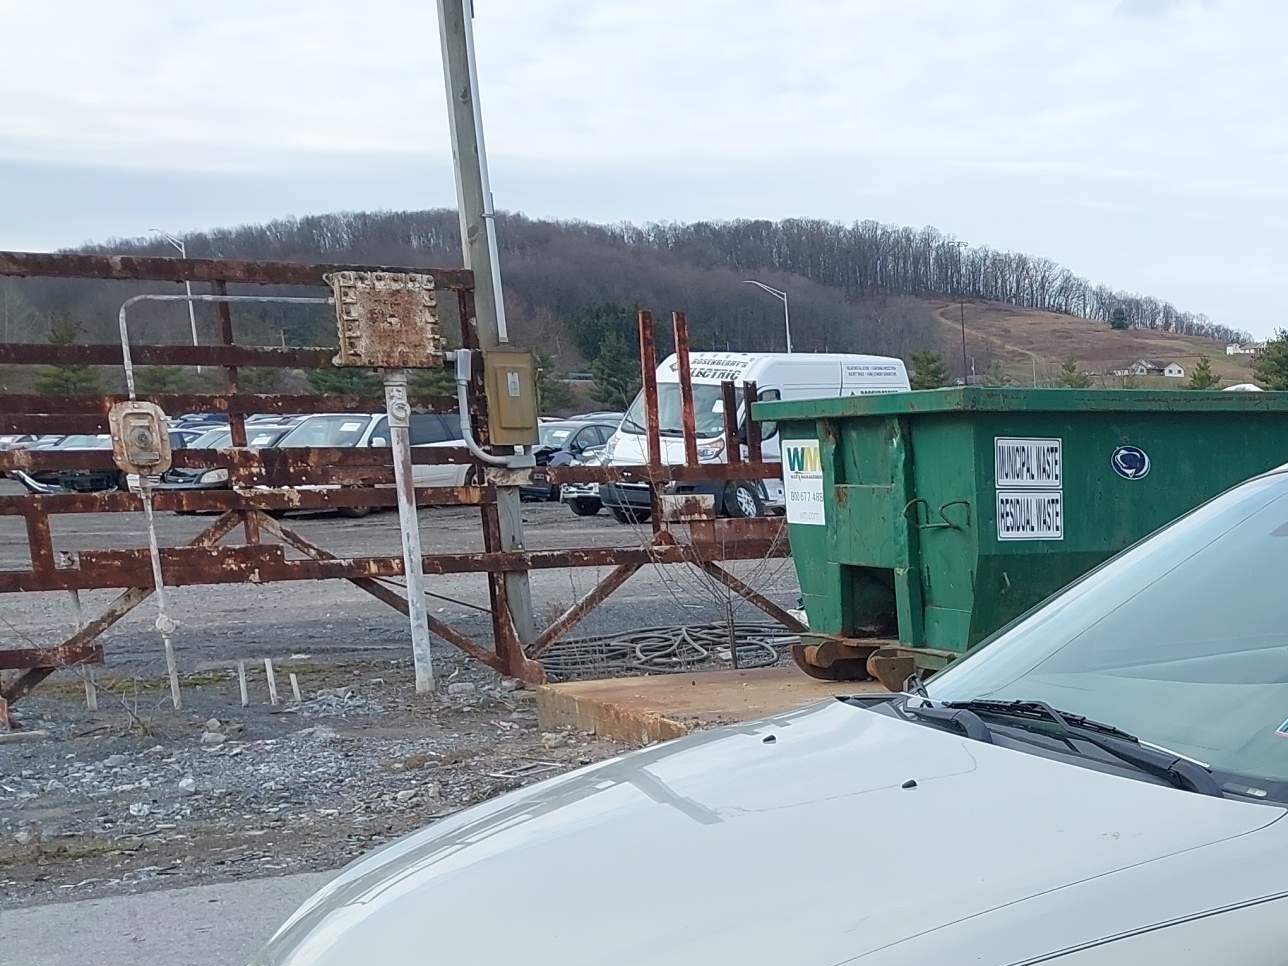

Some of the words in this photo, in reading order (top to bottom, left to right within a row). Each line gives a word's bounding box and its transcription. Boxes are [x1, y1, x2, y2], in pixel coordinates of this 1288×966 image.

[690, 367, 741, 380] LECTRIC
[787, 447, 820, 471] WM
[999, 446, 1034, 480] MUNICIPAL
[1036, 447, 1059, 480] WASTE
[1000, 498, 1034, 532] RESIDUAL
[1036, 498, 1060, 532] WASTE
